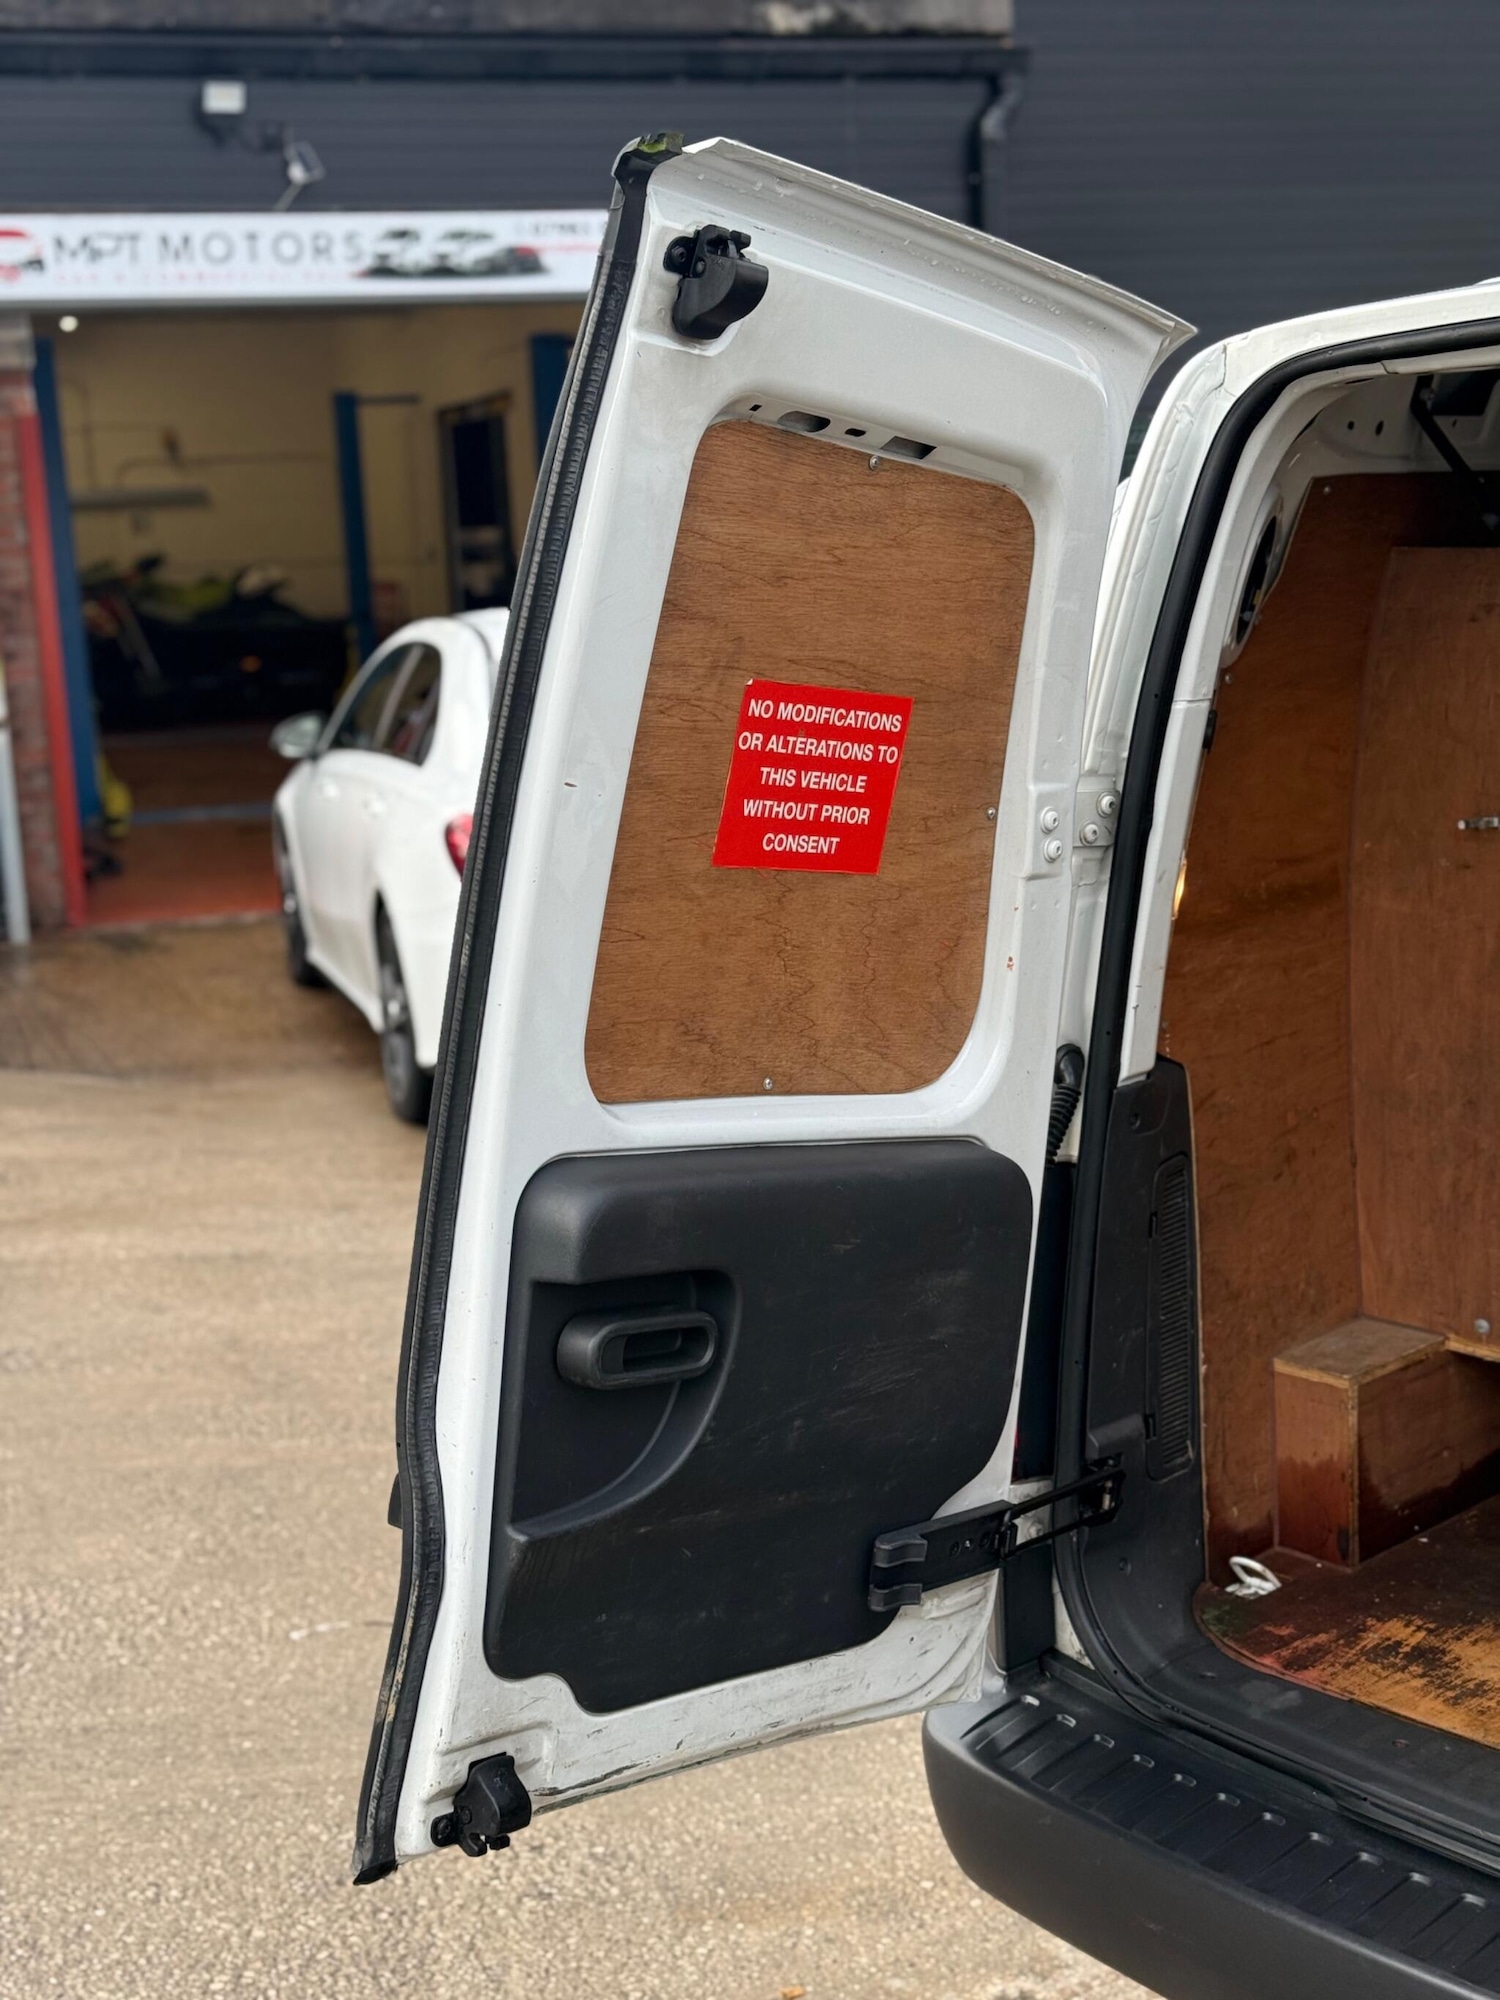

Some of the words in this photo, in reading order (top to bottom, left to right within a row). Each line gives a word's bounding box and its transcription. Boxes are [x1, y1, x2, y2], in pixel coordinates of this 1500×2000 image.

[54, 231, 142, 266] MPT
[159, 229, 363, 265] MOTORS
[748, 698, 774, 719] NO
[776, 701, 902, 732] MODIFICATIONS
[738, 731, 763, 751] OR
[765, 735, 874, 762] ALTERATIONS
[877, 745, 899, 764] TO
[760, 766, 797, 788] THIS
[800, 770, 868, 793] VEHICLE
[743, 798, 819, 821] WITHOUT
[820, 804, 871, 825] PRIOR
[762, 832, 841, 855] CONSENT
